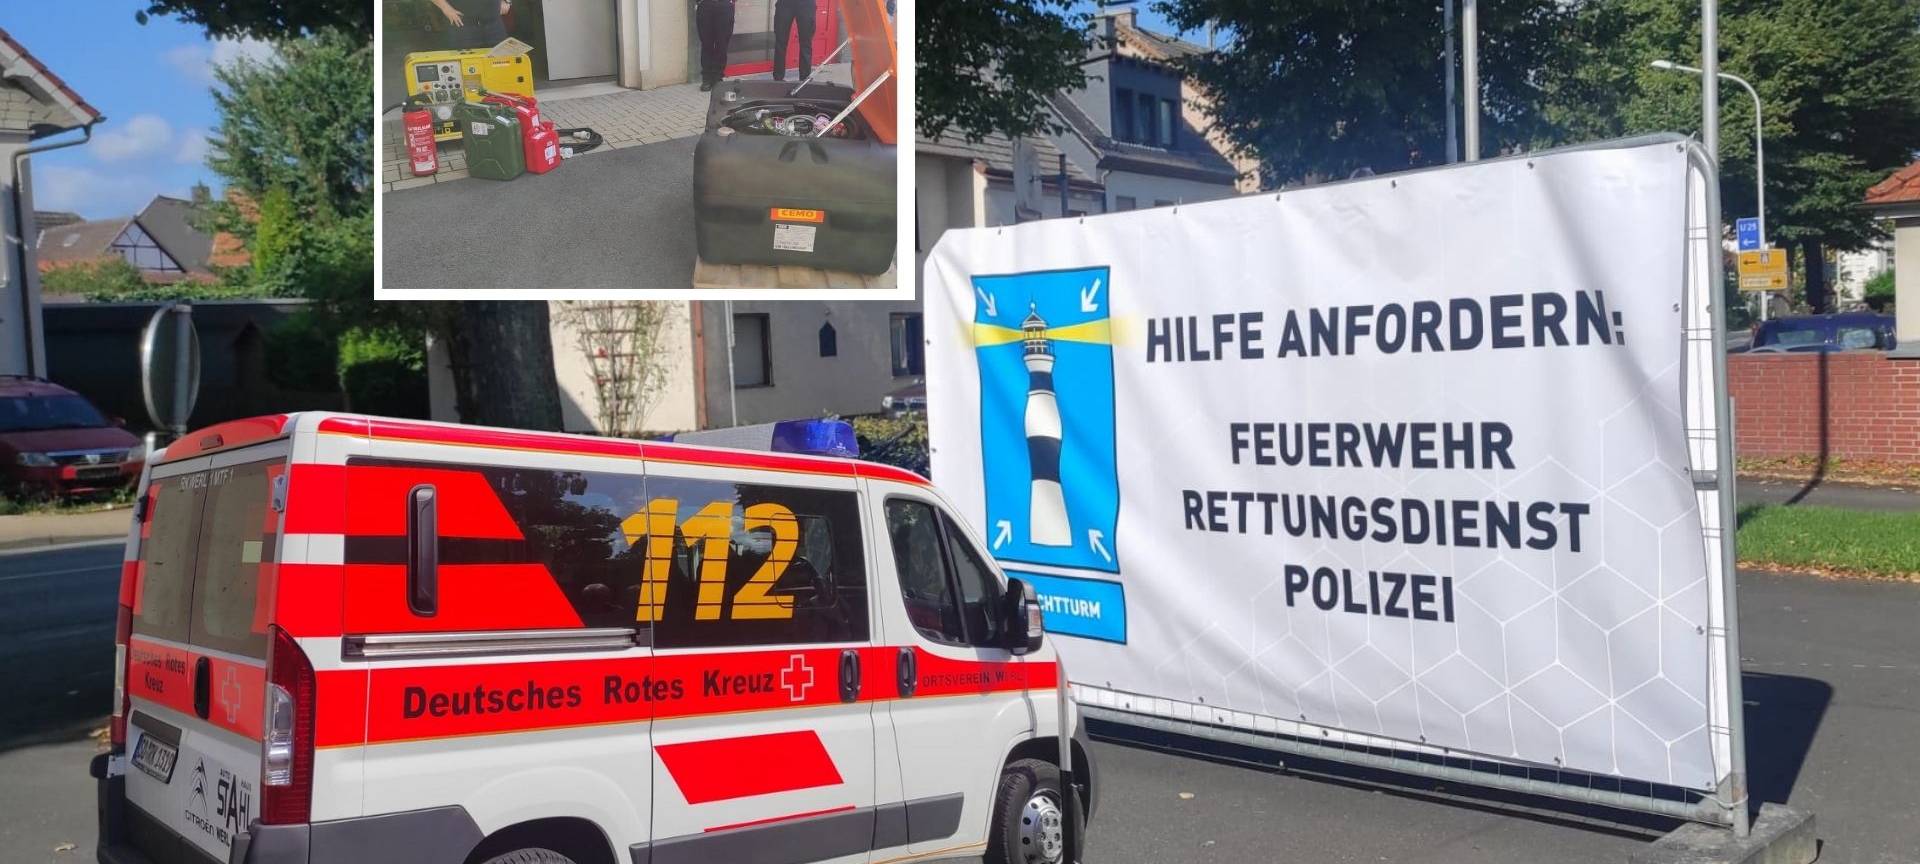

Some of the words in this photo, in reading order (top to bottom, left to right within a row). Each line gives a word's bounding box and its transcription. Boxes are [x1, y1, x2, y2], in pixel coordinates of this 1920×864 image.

[781, 209, 814, 218] CEMO
[1146, 312, 1264, 362] HILFE
[1278, 290, 1625, 358] ANFORDERN:
[1230, 422, 1516, 469] FEUERWEHR
[1182, 490, 1590, 552] RETTUNGSDIENST
[620, 497, 799, 621] 112
[1036, 593, 1100, 619] CHTTURM
[1284, 564, 1455, 622] POLIZEI
[145, 671, 164, 692] Kreuz
[166, 654, 186, 675] Rotes
[922, 671, 990, 687] ORTSVEREIN
[404, 679, 581, 719] Deutsches
[604, 674, 684, 704] Rotes
[703, 669, 775, 697] Kreuz
[220, 768, 230, 780] AUTO
[216, 774, 250, 834] STAHL
[216, 826, 230, 847] WERL
